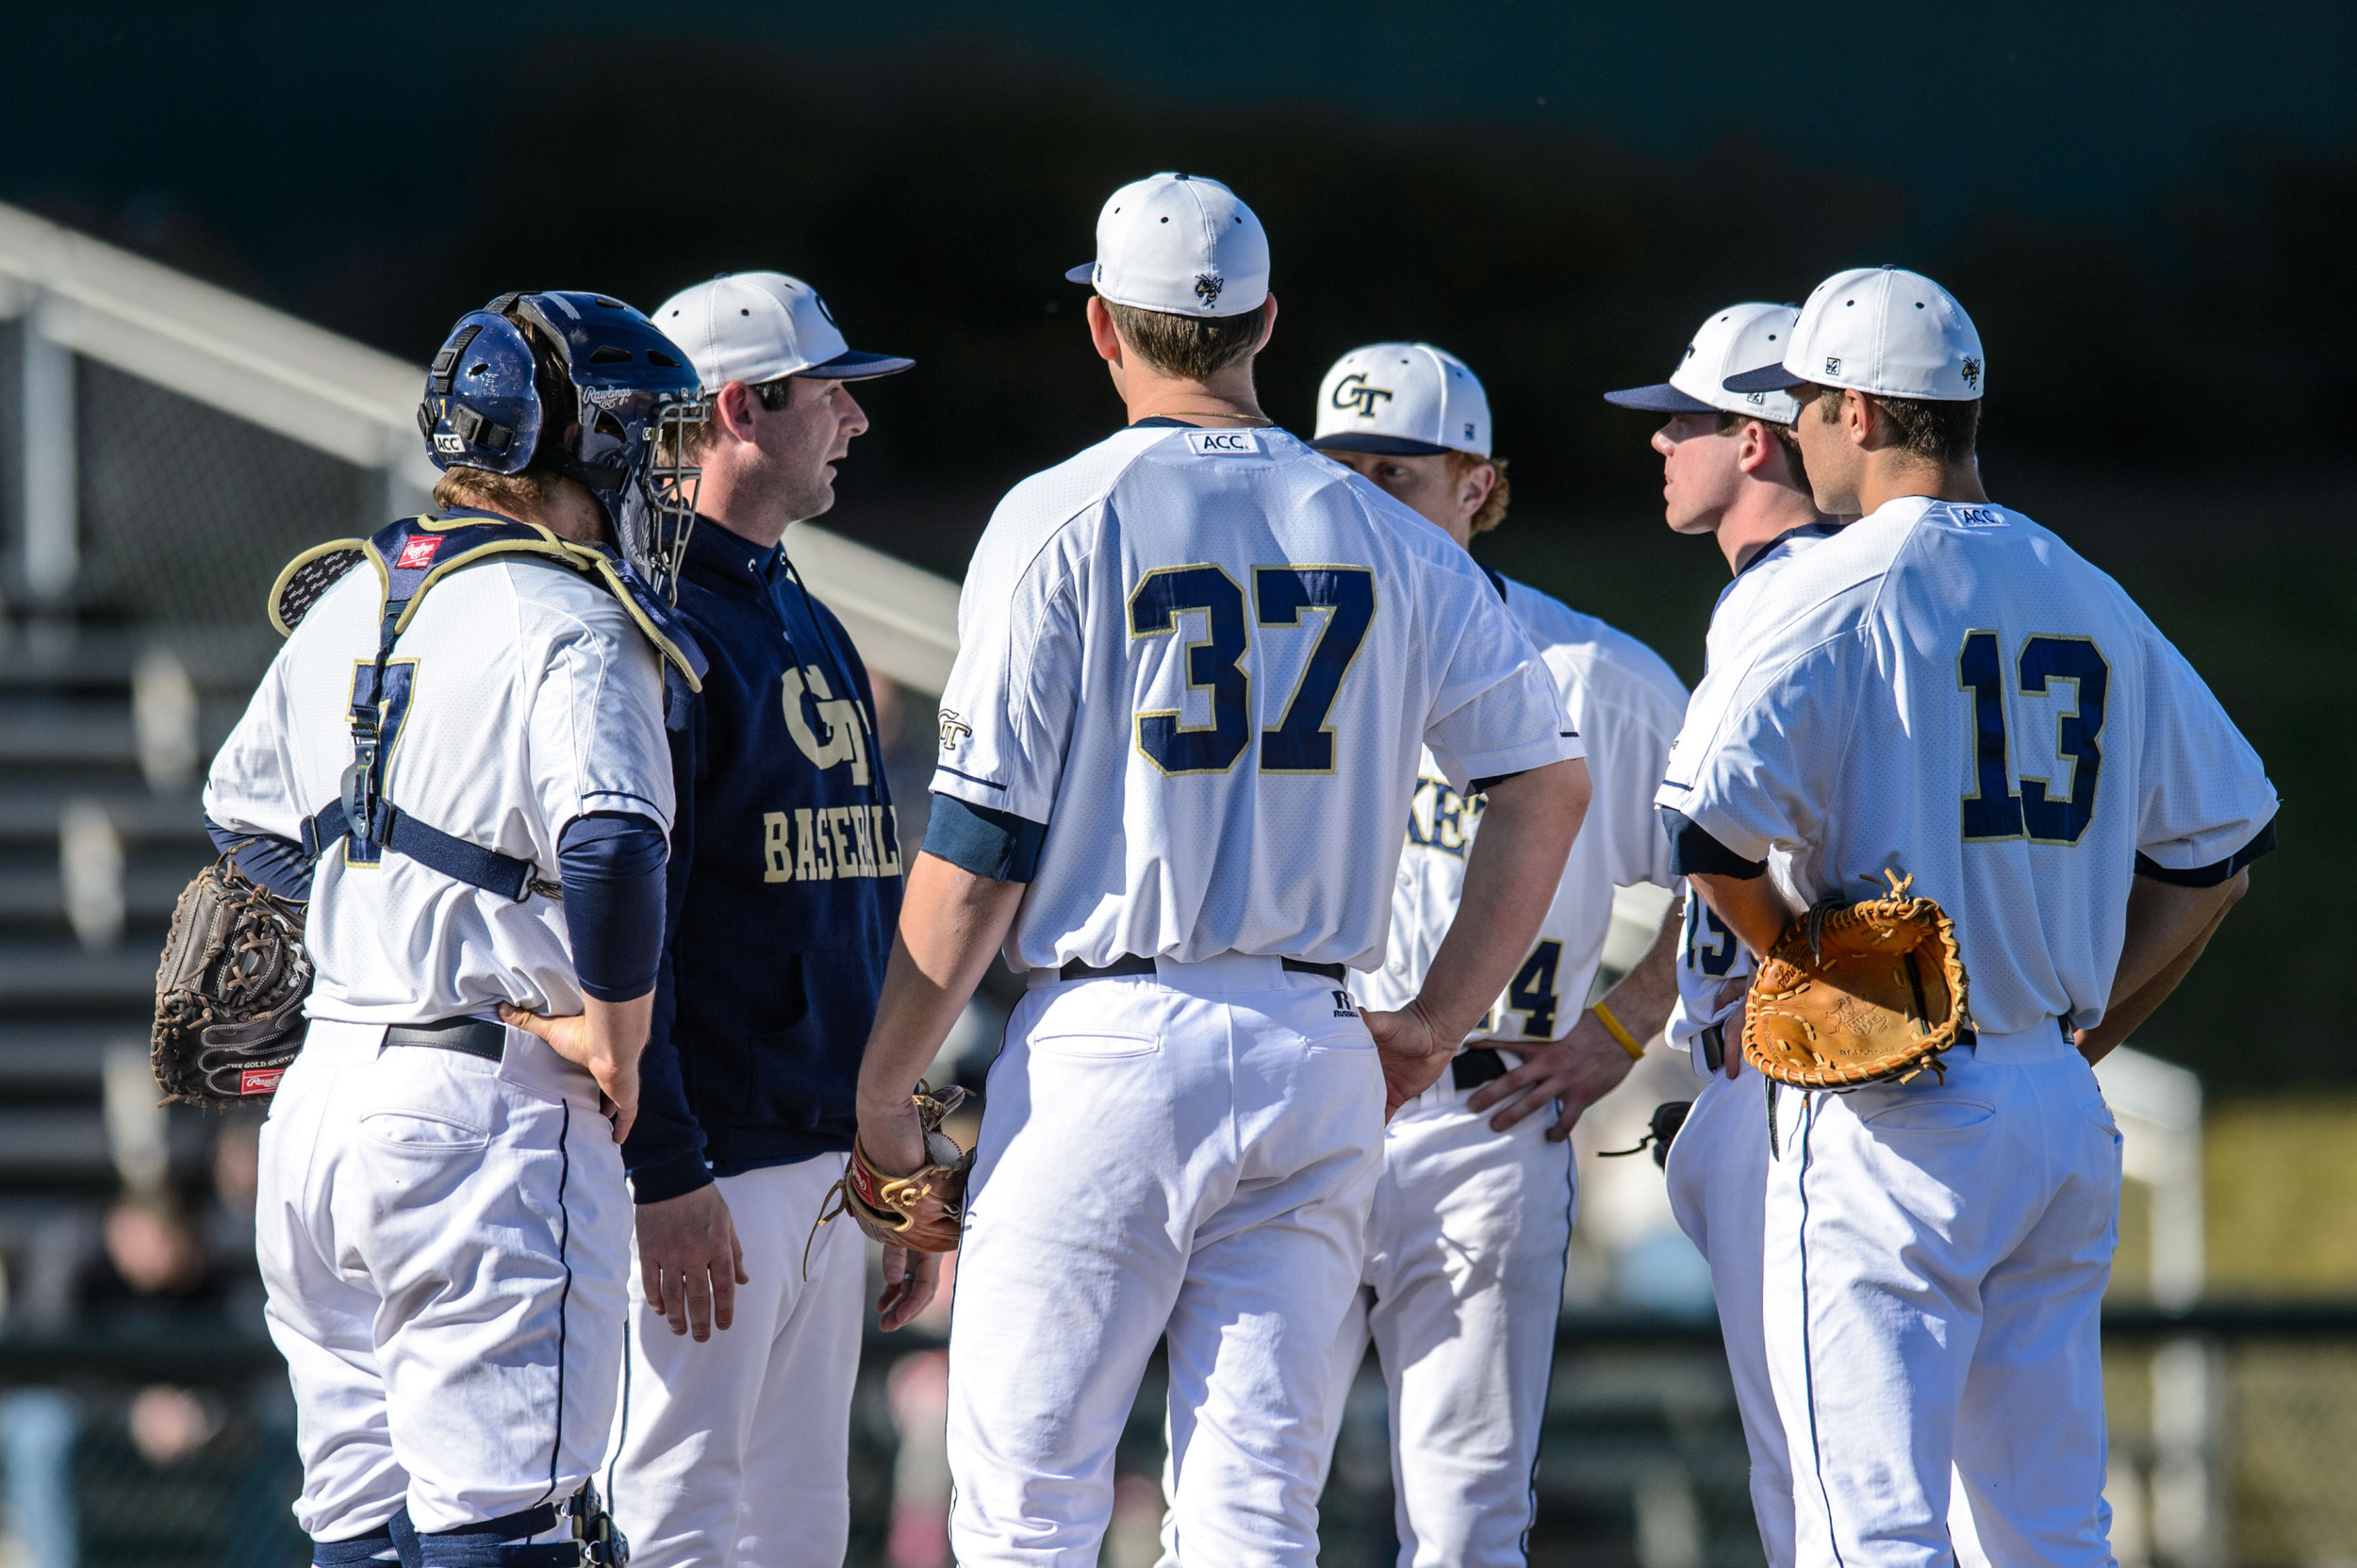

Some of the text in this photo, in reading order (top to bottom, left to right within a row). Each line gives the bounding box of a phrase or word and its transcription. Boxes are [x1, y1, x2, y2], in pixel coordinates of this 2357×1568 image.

[583, 385, 632, 405] Rawlings
[1331, 372, 1393, 418] GT
[439, 398, 446, 420] 7
[437, 437, 459, 451] ACC
[1204, 436, 1244, 449] ACC
[1963, 509, 1995, 523] ACC
[1128, 563, 1377, 778] 37
[782, 665, 871, 786] GT
[1956, 628, 2112, 847] 13
[345, 657, 420, 868] 7
[244, 1061, 267, 1069] GOLD
[268, 1053, 296, 1066] GLOVE
